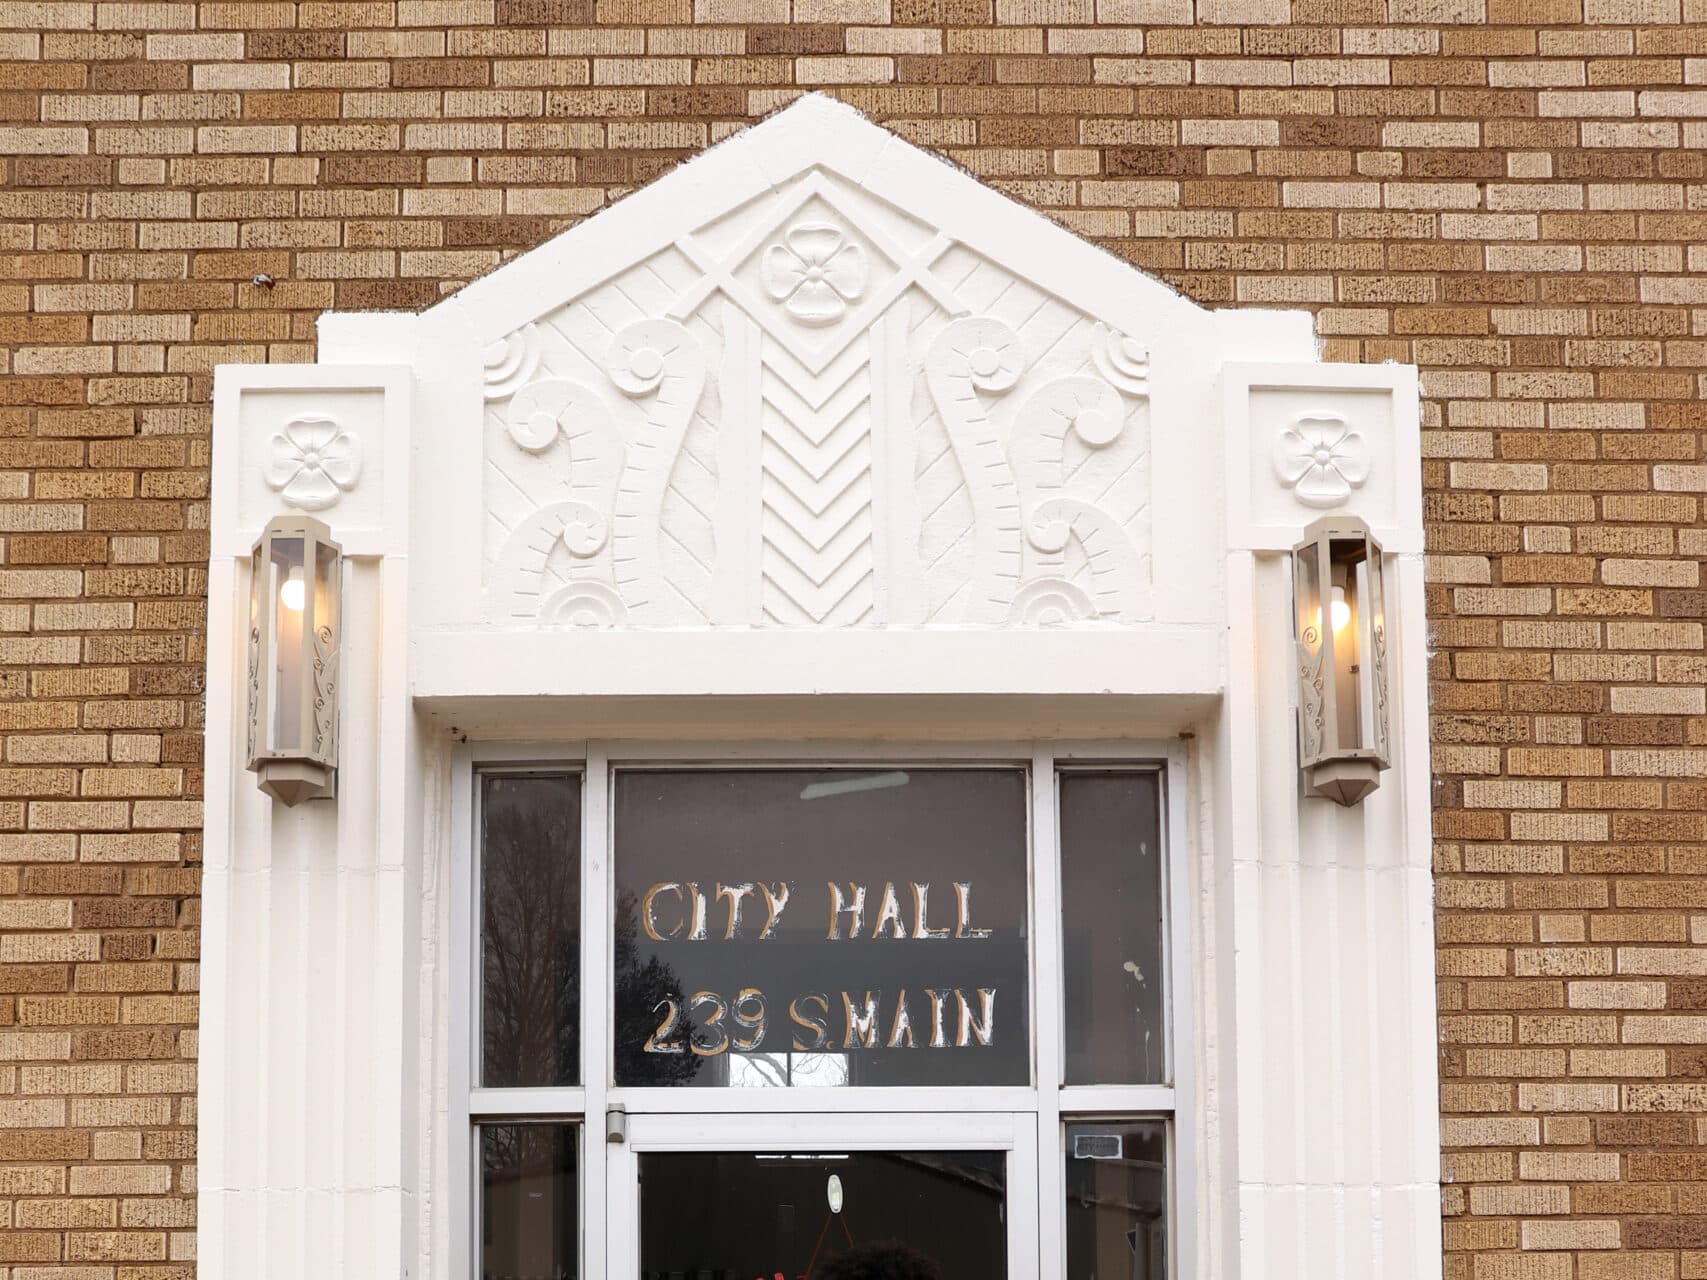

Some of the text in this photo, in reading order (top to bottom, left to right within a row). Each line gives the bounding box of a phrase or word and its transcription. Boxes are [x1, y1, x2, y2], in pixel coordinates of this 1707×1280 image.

[642, 881, 993, 941] CITY HALL
[643, 987, 769, 1056] 239
